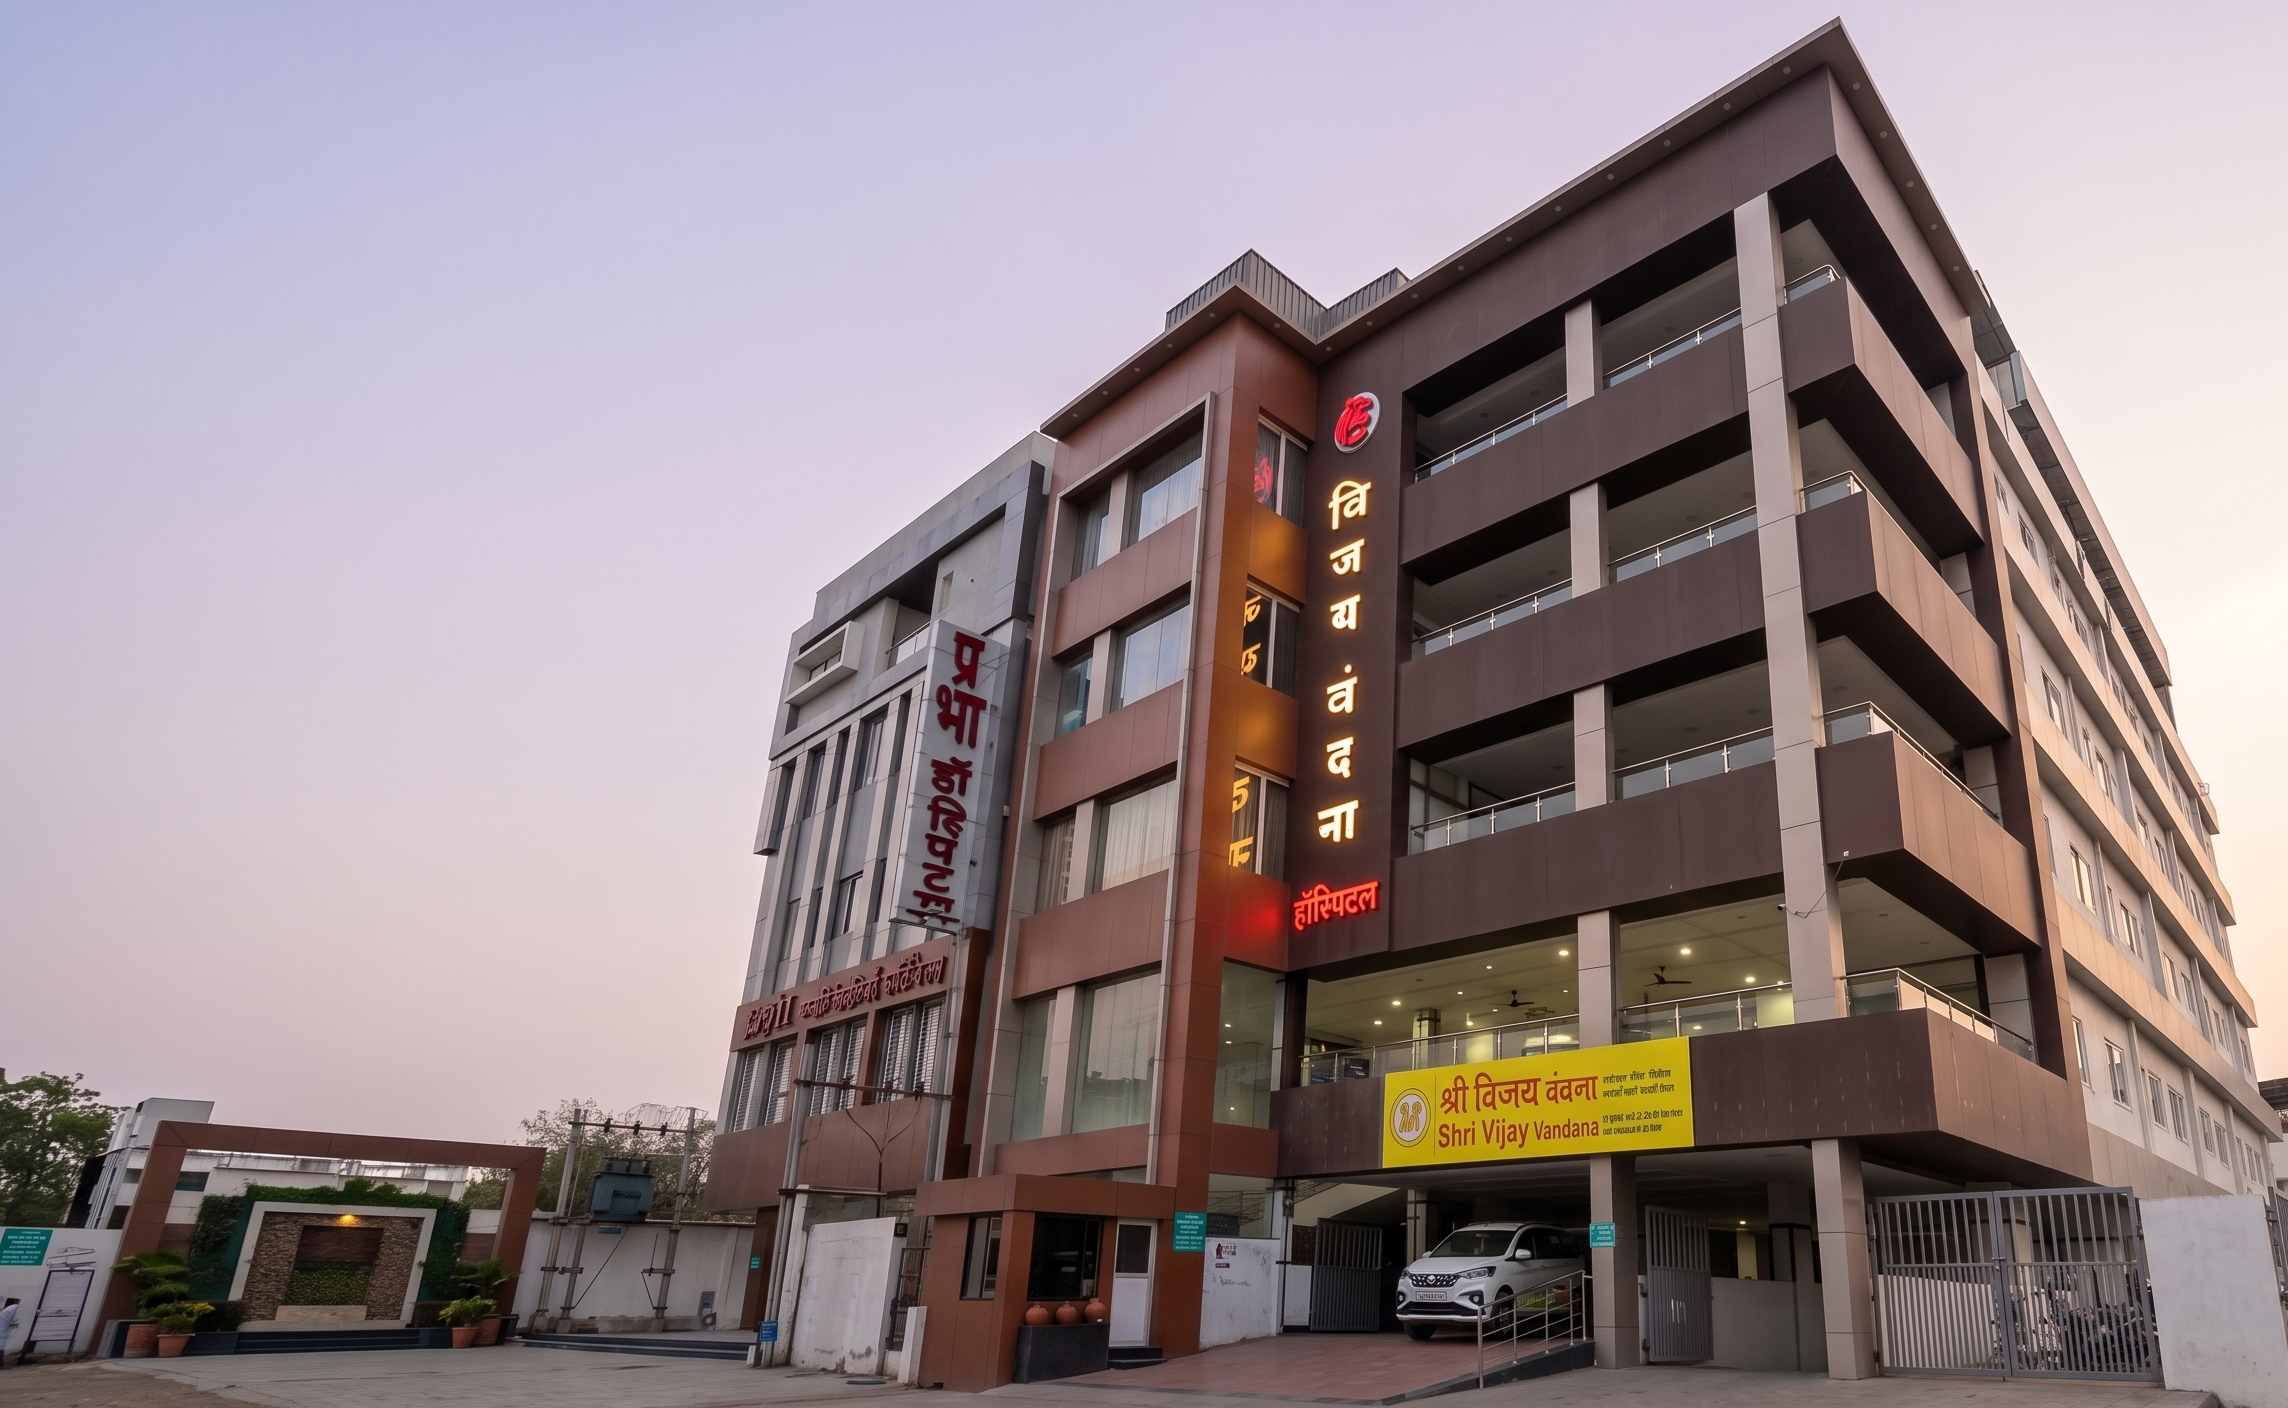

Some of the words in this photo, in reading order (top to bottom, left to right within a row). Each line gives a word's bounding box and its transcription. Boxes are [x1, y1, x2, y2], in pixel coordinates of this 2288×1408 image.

[1293, 880, 1379, 931] हॉस्पिटल
[1440, 1074, 1470, 1115] श्री
[1473, 1072, 1542, 1112] विजय
[1438, 1121, 1476, 1149] Shri
[1481, 1118, 1530, 1150] Vijay
[1533, 1118, 1600, 1141] Vandana
